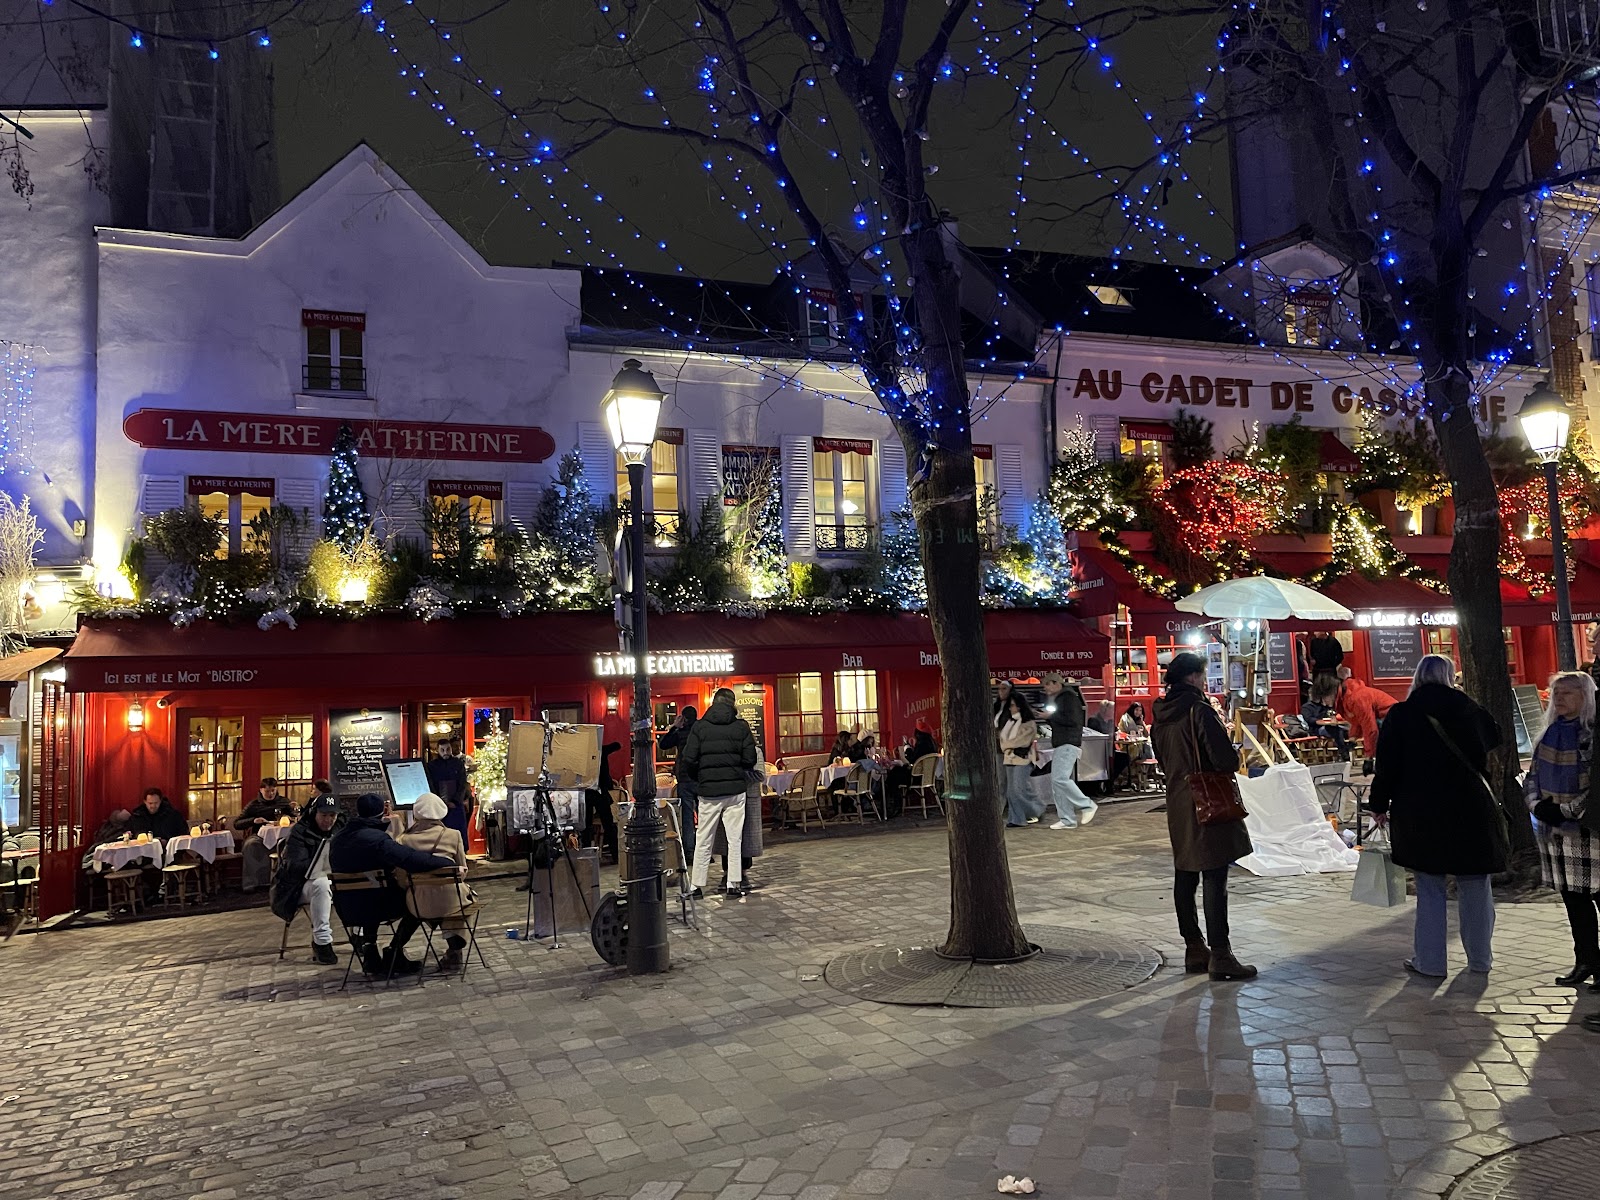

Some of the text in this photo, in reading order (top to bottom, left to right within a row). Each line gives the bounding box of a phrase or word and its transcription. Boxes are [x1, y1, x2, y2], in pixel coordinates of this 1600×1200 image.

[303, 312, 365, 323] LA MERE CATHERINE
[1073, 368, 1508, 424] AU CADET DE GASCE
[162, 418, 523, 455] LA MERE ATHERINE
[1129, 429, 1174, 441] Restaurant
[840, 440, 871, 449] CATHERINE
[725, 469, 740, 480] du
[192, 478, 272, 489] LA MERE CATHERINE
[442, 483, 462, 491] MERE
[463, 484, 502, 493] CATHERINE
[1070, 576, 1105, 592] estaurant
[1165, 619, 1191, 632] Café
[842, 652, 864, 668] BAR
[919, 650, 942, 666] BRA
[1066, 651, 1075, 660] EN
[1077, 650, 1094, 660] 1793
[595, 657, 616, 675] LA
[658, 653, 735, 674] CATHERINE
[104, 671, 119, 684] ICI
[124, 673, 142, 684] EST
[162, 673, 174, 683] LE
[178, 670, 201, 683] MOT
[1008, 669, 1022, 678] MER
[1027, 669, 1048, 678] VENTE
[903, 695, 936, 719] JARDIN
